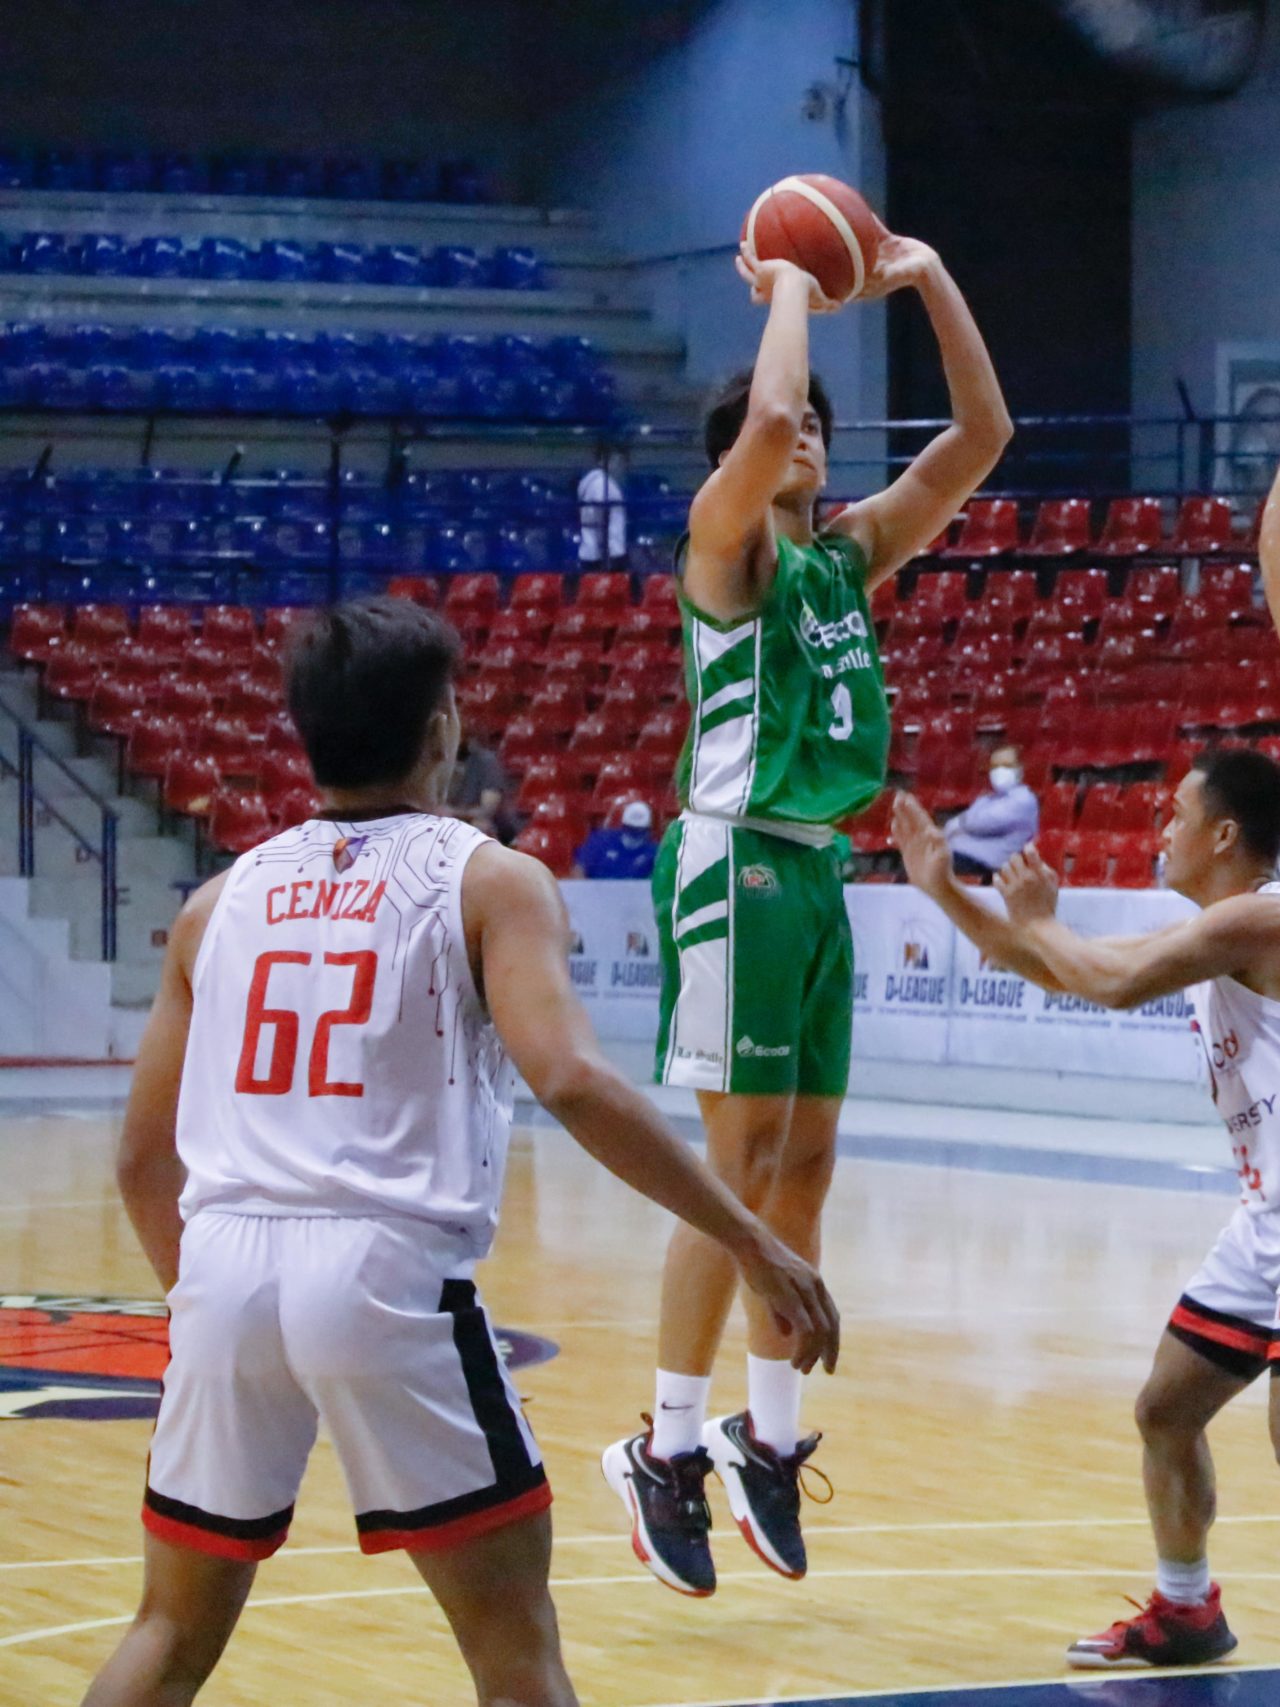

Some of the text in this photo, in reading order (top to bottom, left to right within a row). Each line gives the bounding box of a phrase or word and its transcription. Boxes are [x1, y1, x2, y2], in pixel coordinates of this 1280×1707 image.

[266, 879, 387, 926] CENIZA
[885, 974, 945, 1005] D-LEAGUE
[960, 976, 1025, 1009] D-LEAGUE
[234, 949, 378, 1098] 62
